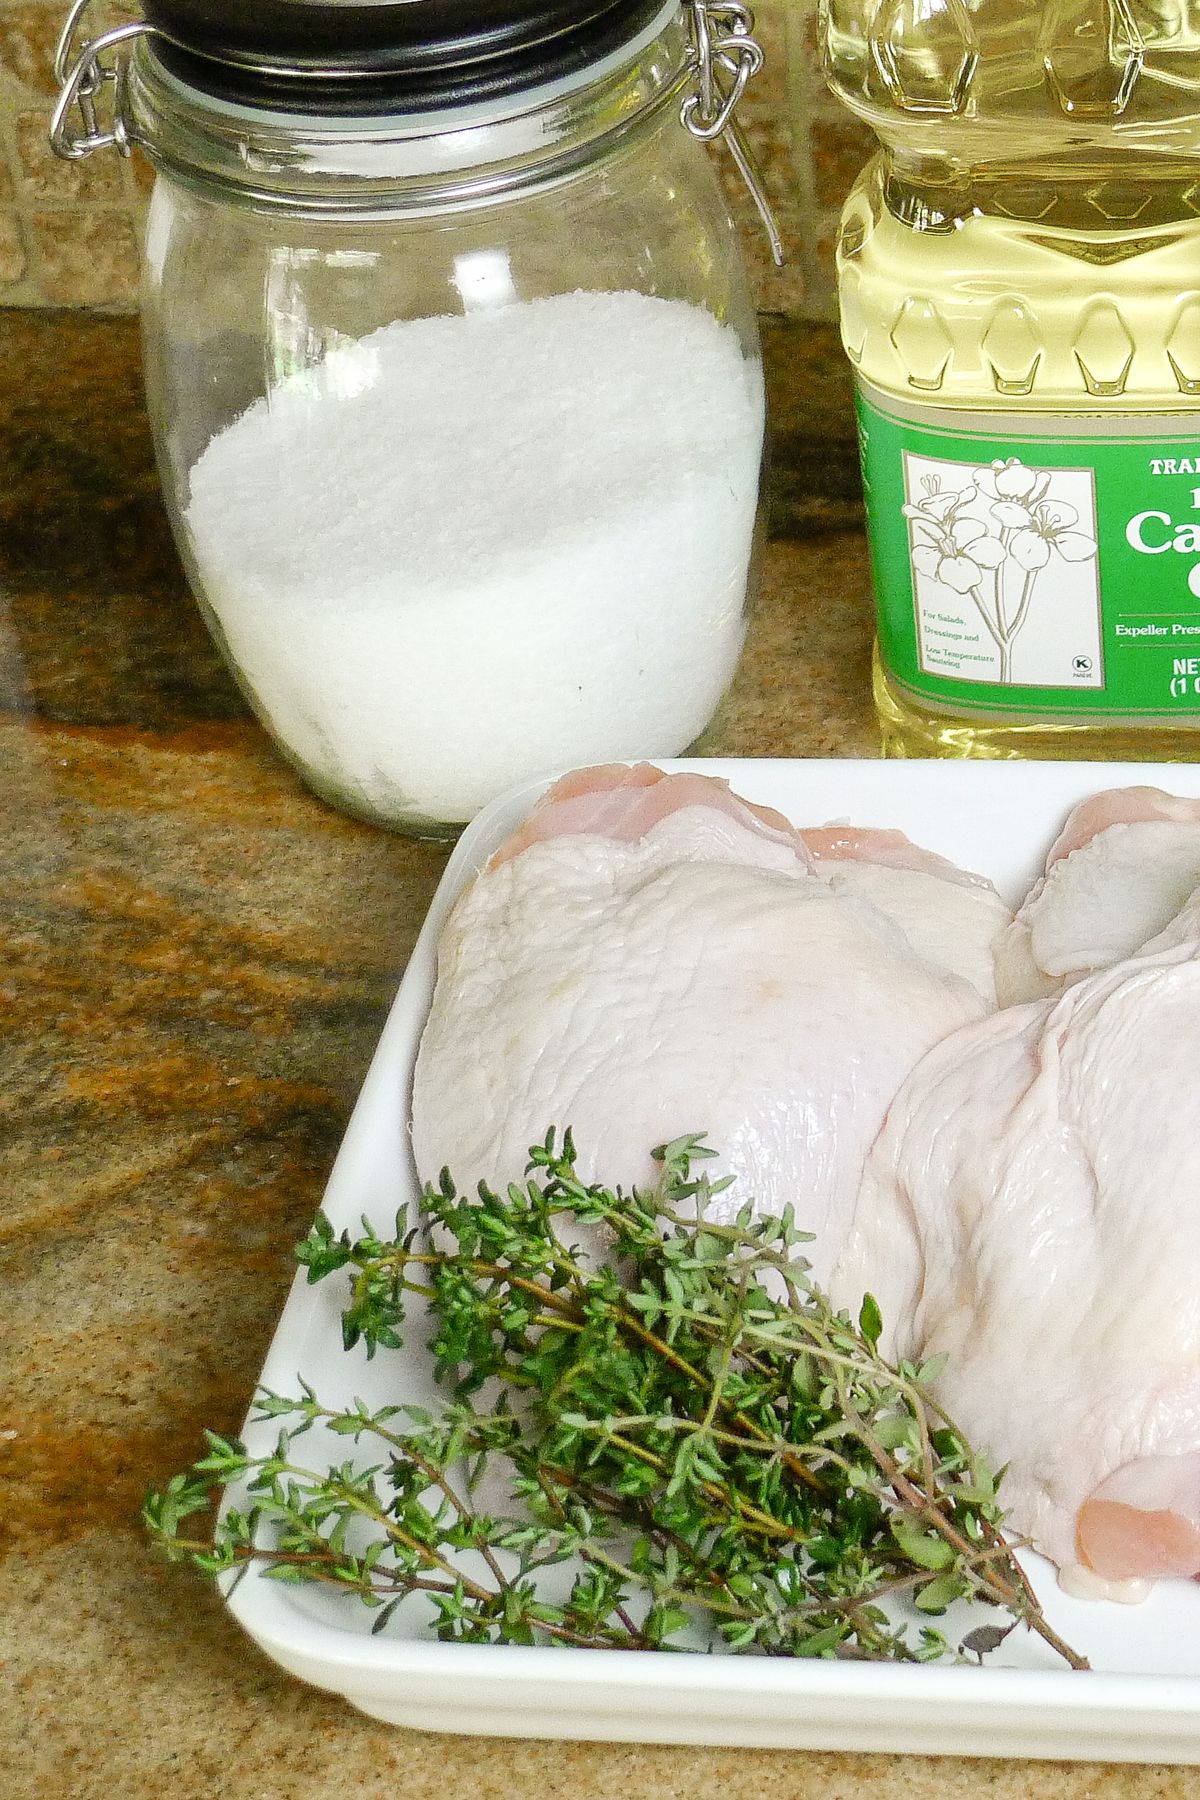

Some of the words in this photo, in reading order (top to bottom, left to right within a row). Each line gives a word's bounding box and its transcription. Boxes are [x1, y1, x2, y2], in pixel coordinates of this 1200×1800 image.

[1115, 623, 1169, 637] Expeller
[943, 649, 995, 662] Temperature
[1170, 678, 1187, 698] (1
